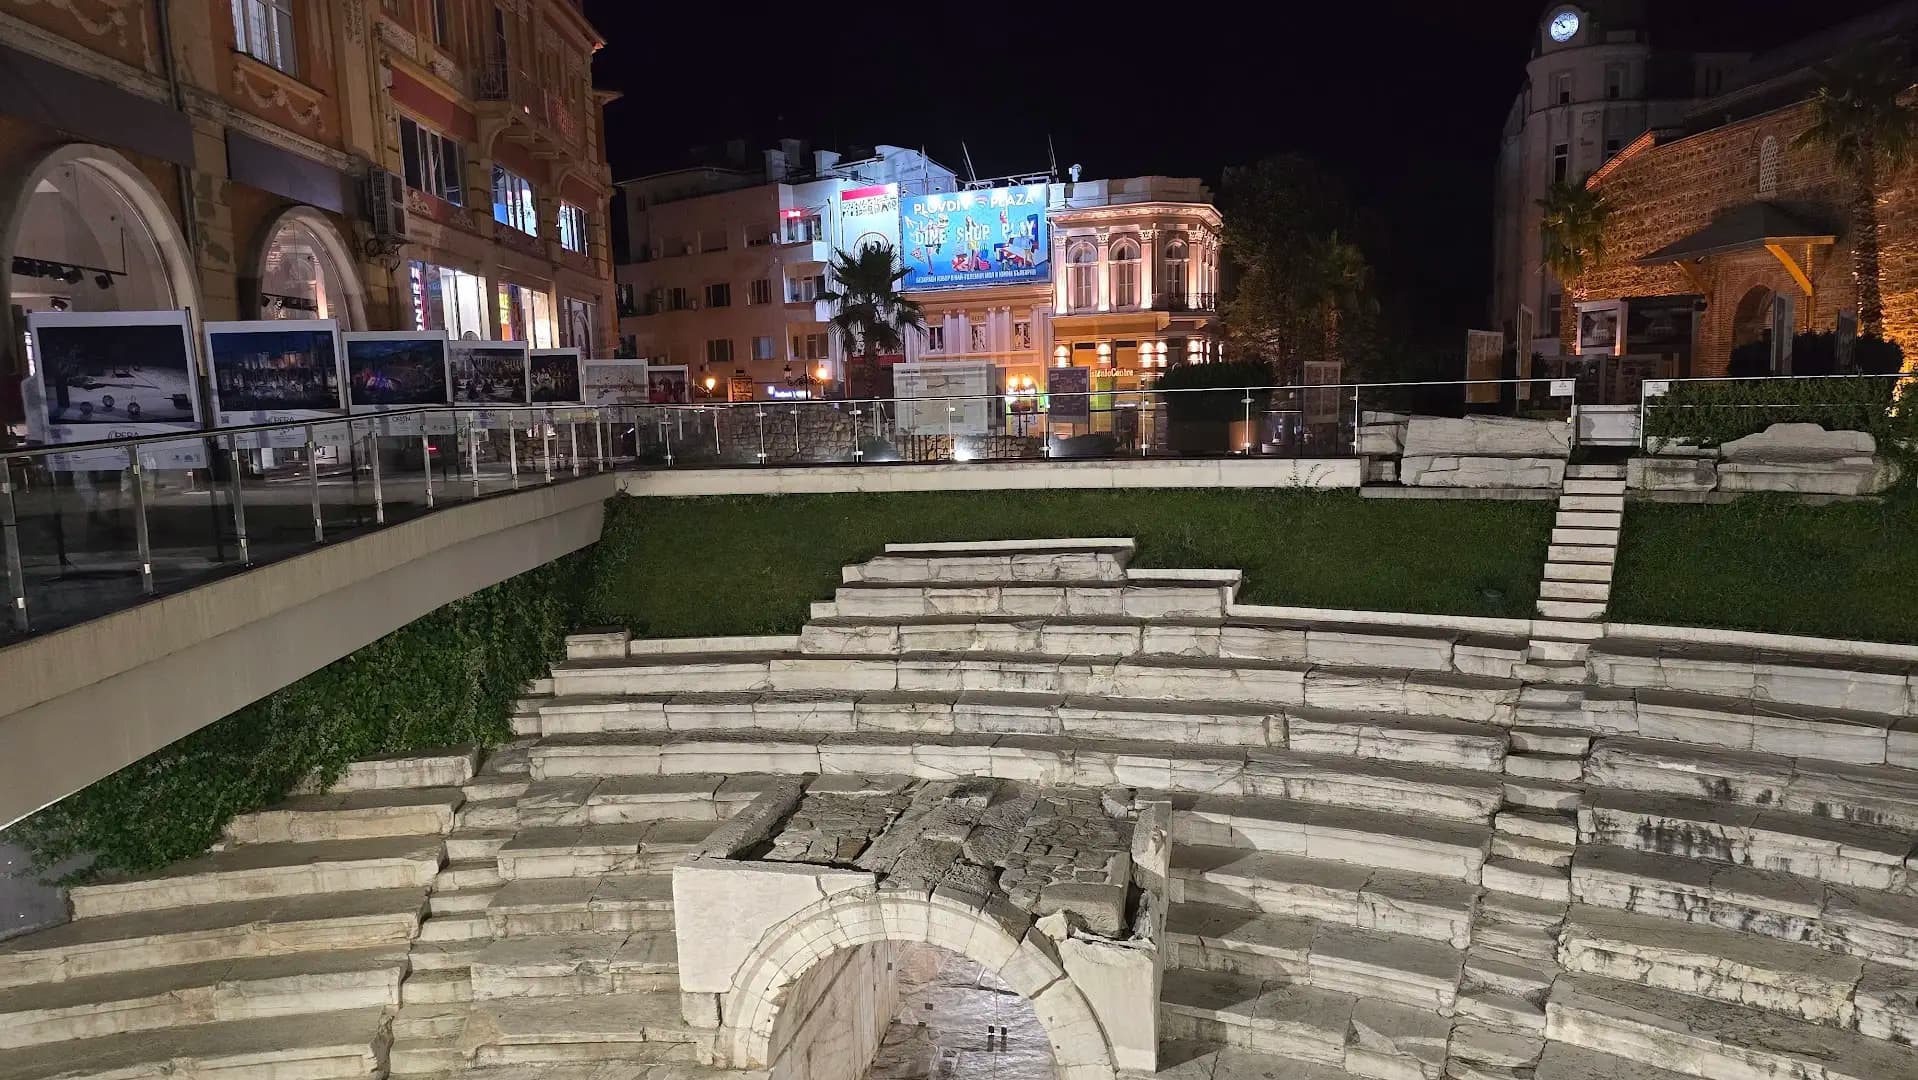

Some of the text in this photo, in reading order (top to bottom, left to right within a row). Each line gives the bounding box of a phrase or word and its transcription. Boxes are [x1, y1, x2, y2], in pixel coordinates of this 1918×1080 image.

[914, 196, 969, 215] PLOVDIV
[990, 191, 1034, 209] PLAZA
[1002, 221, 1035, 239] PLAY
